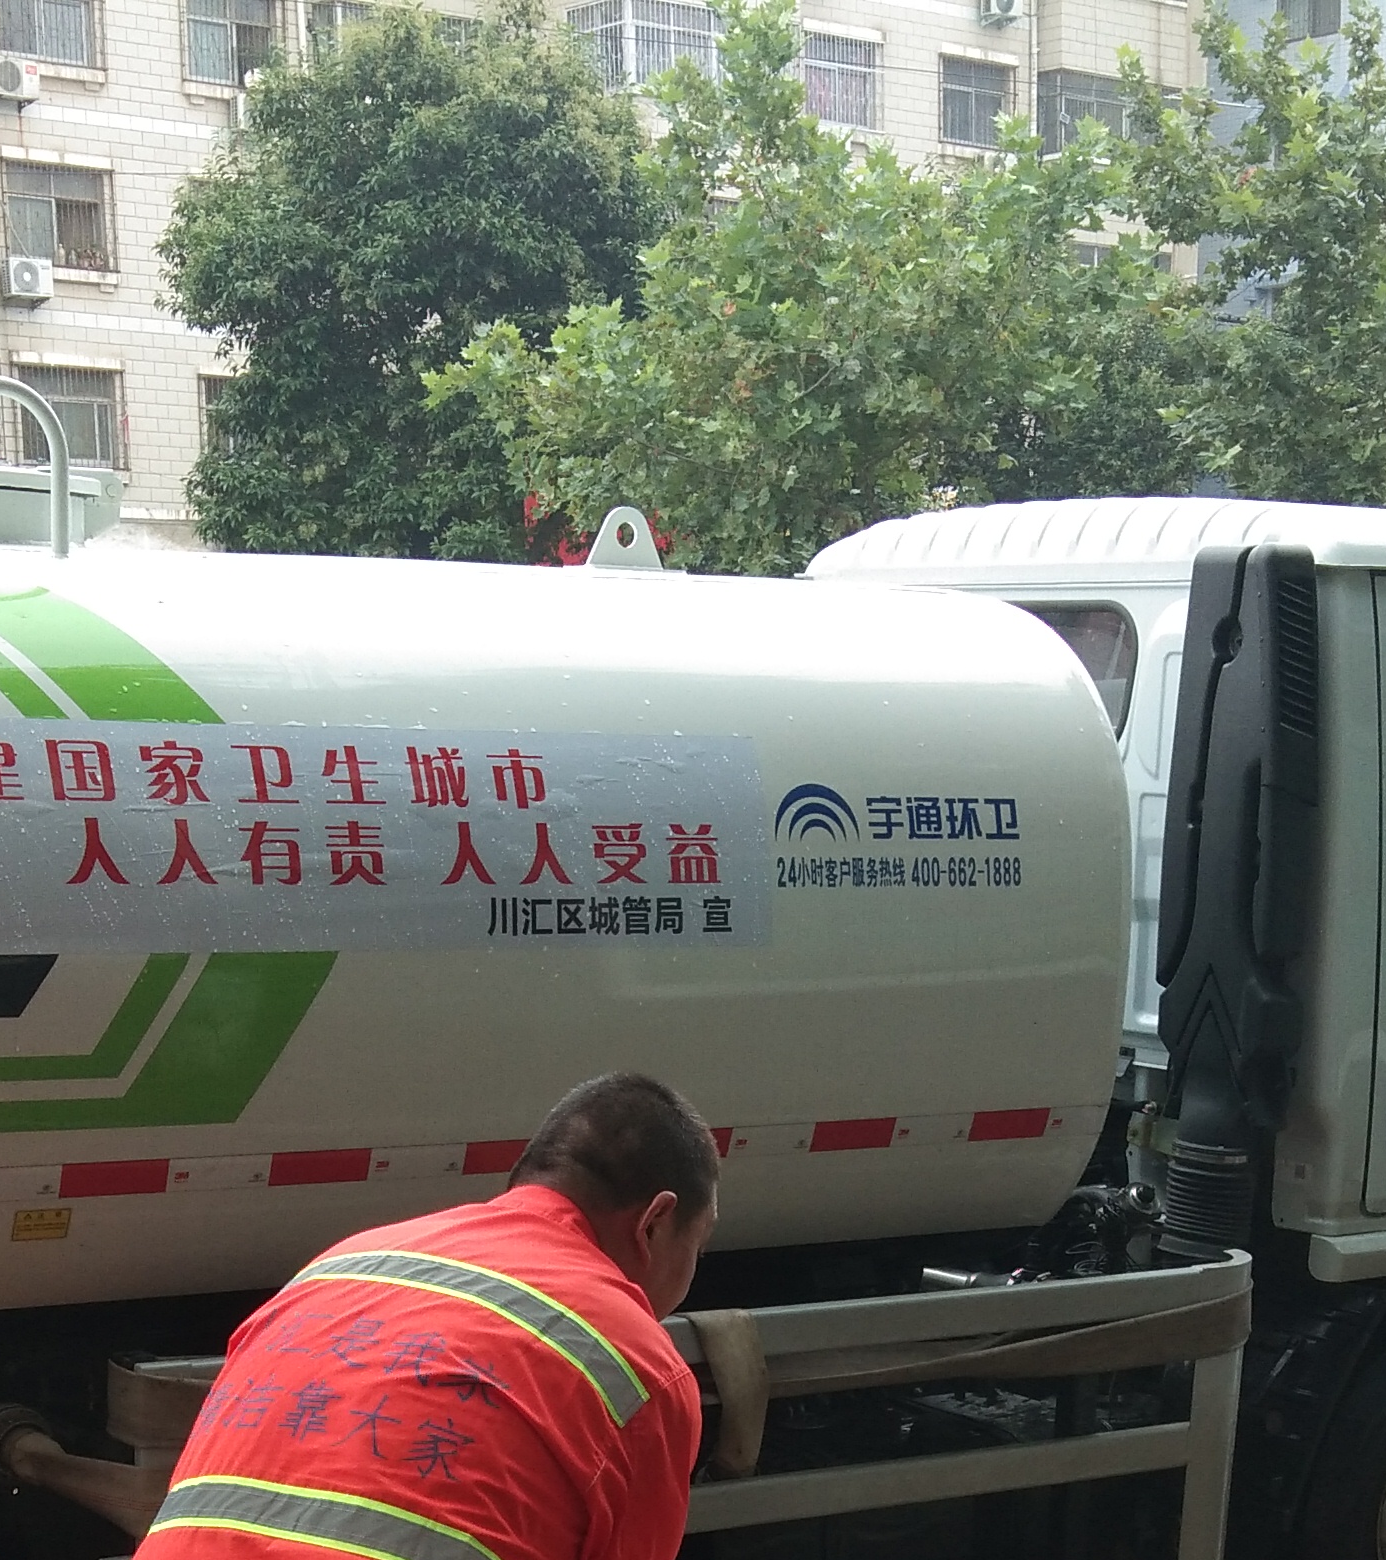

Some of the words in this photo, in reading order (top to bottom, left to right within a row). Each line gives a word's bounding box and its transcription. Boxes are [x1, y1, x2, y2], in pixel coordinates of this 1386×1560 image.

[866, 796, 1021, 840] 宇通环卫
[66, 817, 388, 886] 人人有责
[440, 821, 722, 886] 人人受益
[777, 857, 906, 888] 24小时客户服务热线
[911, 856, 1022, 887] 400-662-1888
[487, 897, 684, 937] 川汇区城管局
[702, 897, 734, 934] 宣
